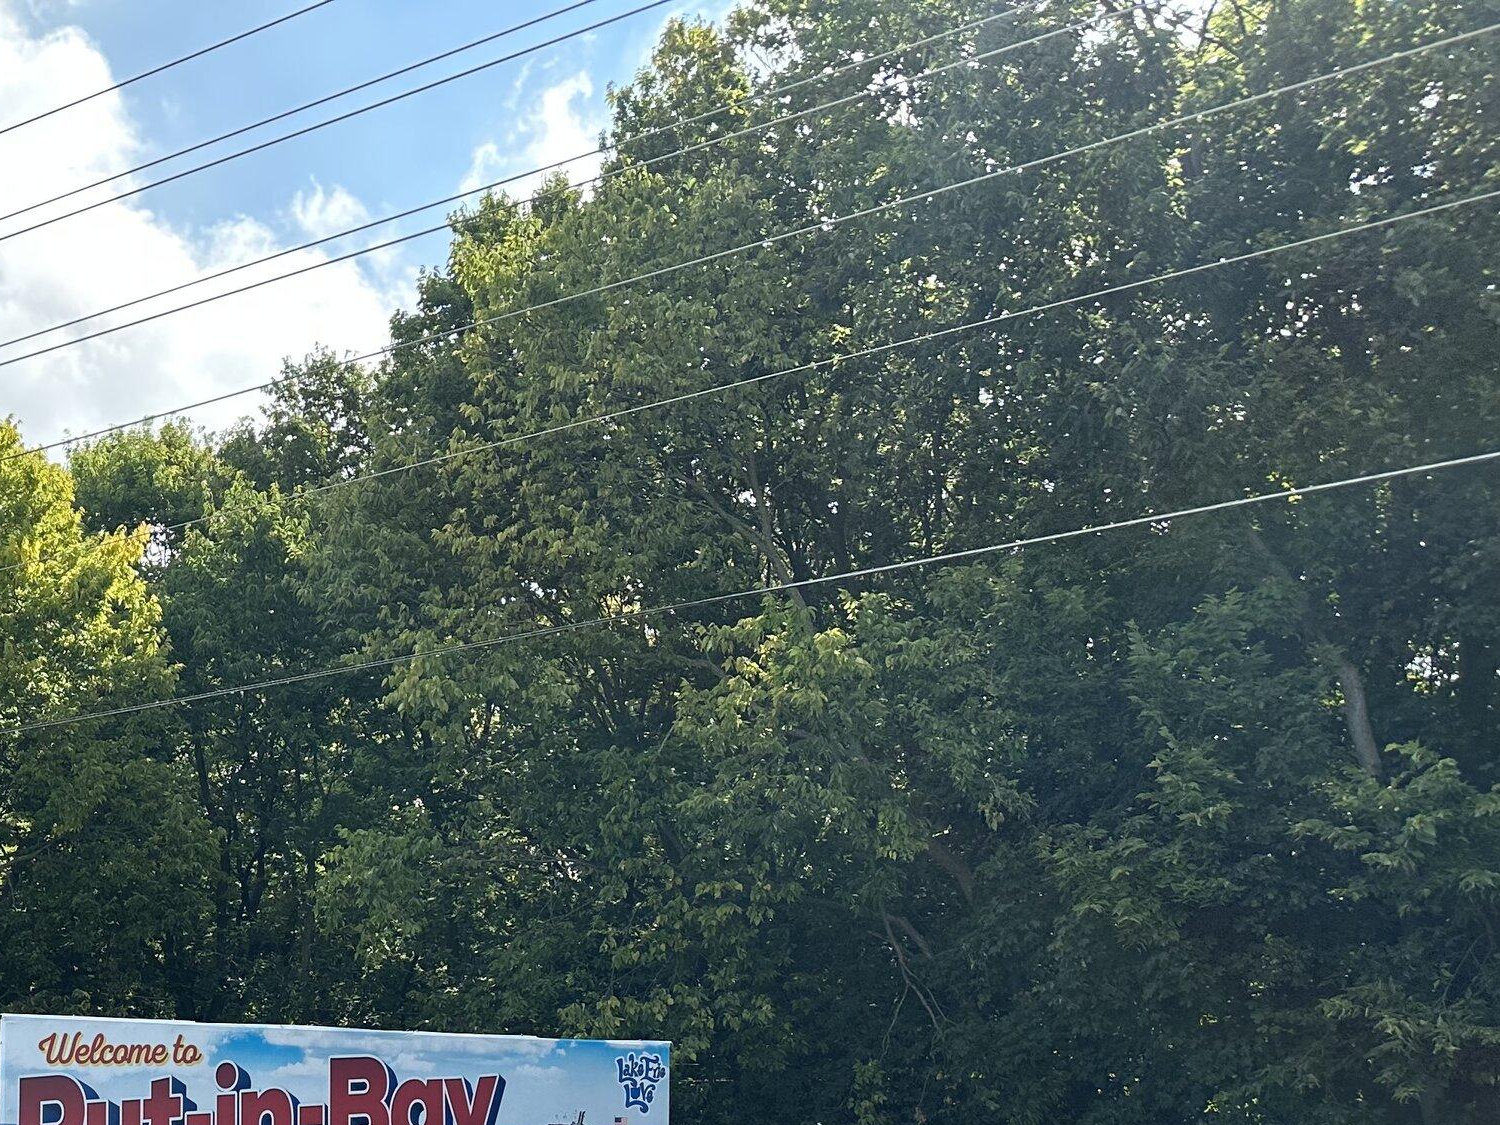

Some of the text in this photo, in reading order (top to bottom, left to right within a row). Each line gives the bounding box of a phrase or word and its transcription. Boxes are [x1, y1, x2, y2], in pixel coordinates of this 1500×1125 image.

[39, 1031, 204, 1066] Welcome to
[616, 1053, 645, 1087] Lake
